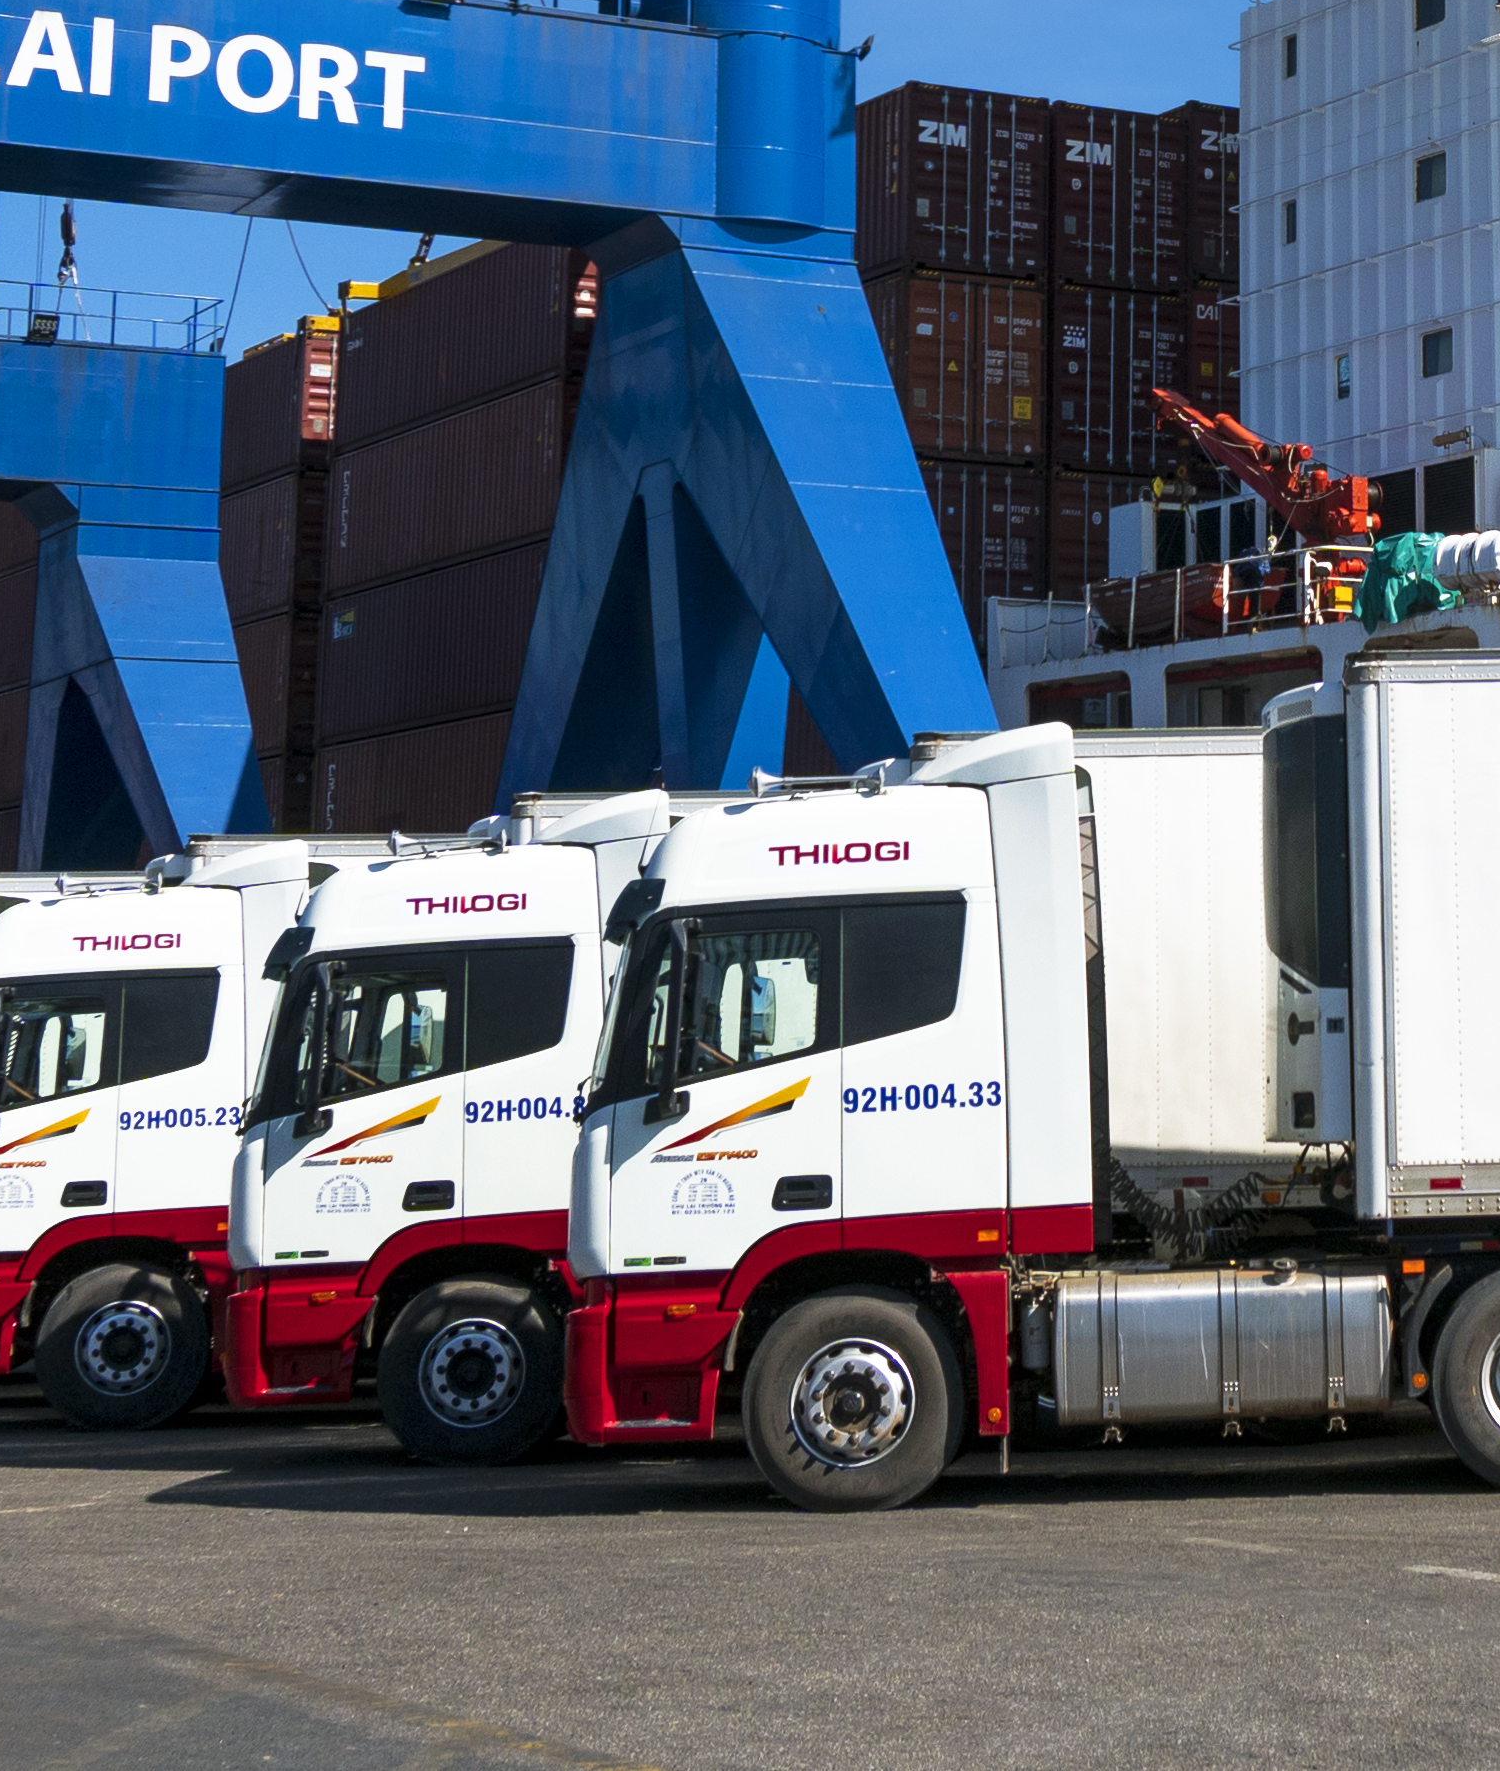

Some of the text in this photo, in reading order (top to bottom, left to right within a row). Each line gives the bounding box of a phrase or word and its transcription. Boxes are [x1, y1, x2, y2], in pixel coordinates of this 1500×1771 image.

[148, 24, 426, 130] PORT
[918, 119, 967, 147] ZIM
[1065, 139, 1112, 166] ZIM
[1062, 336, 1086, 349] ZIM
[768, 841, 910, 867] THILOGI
[405, 893, 527, 916] THILOGI
[72, 933, 181, 952] THILOGI
[464, 1095, 587, 1124] 92H-004.8
